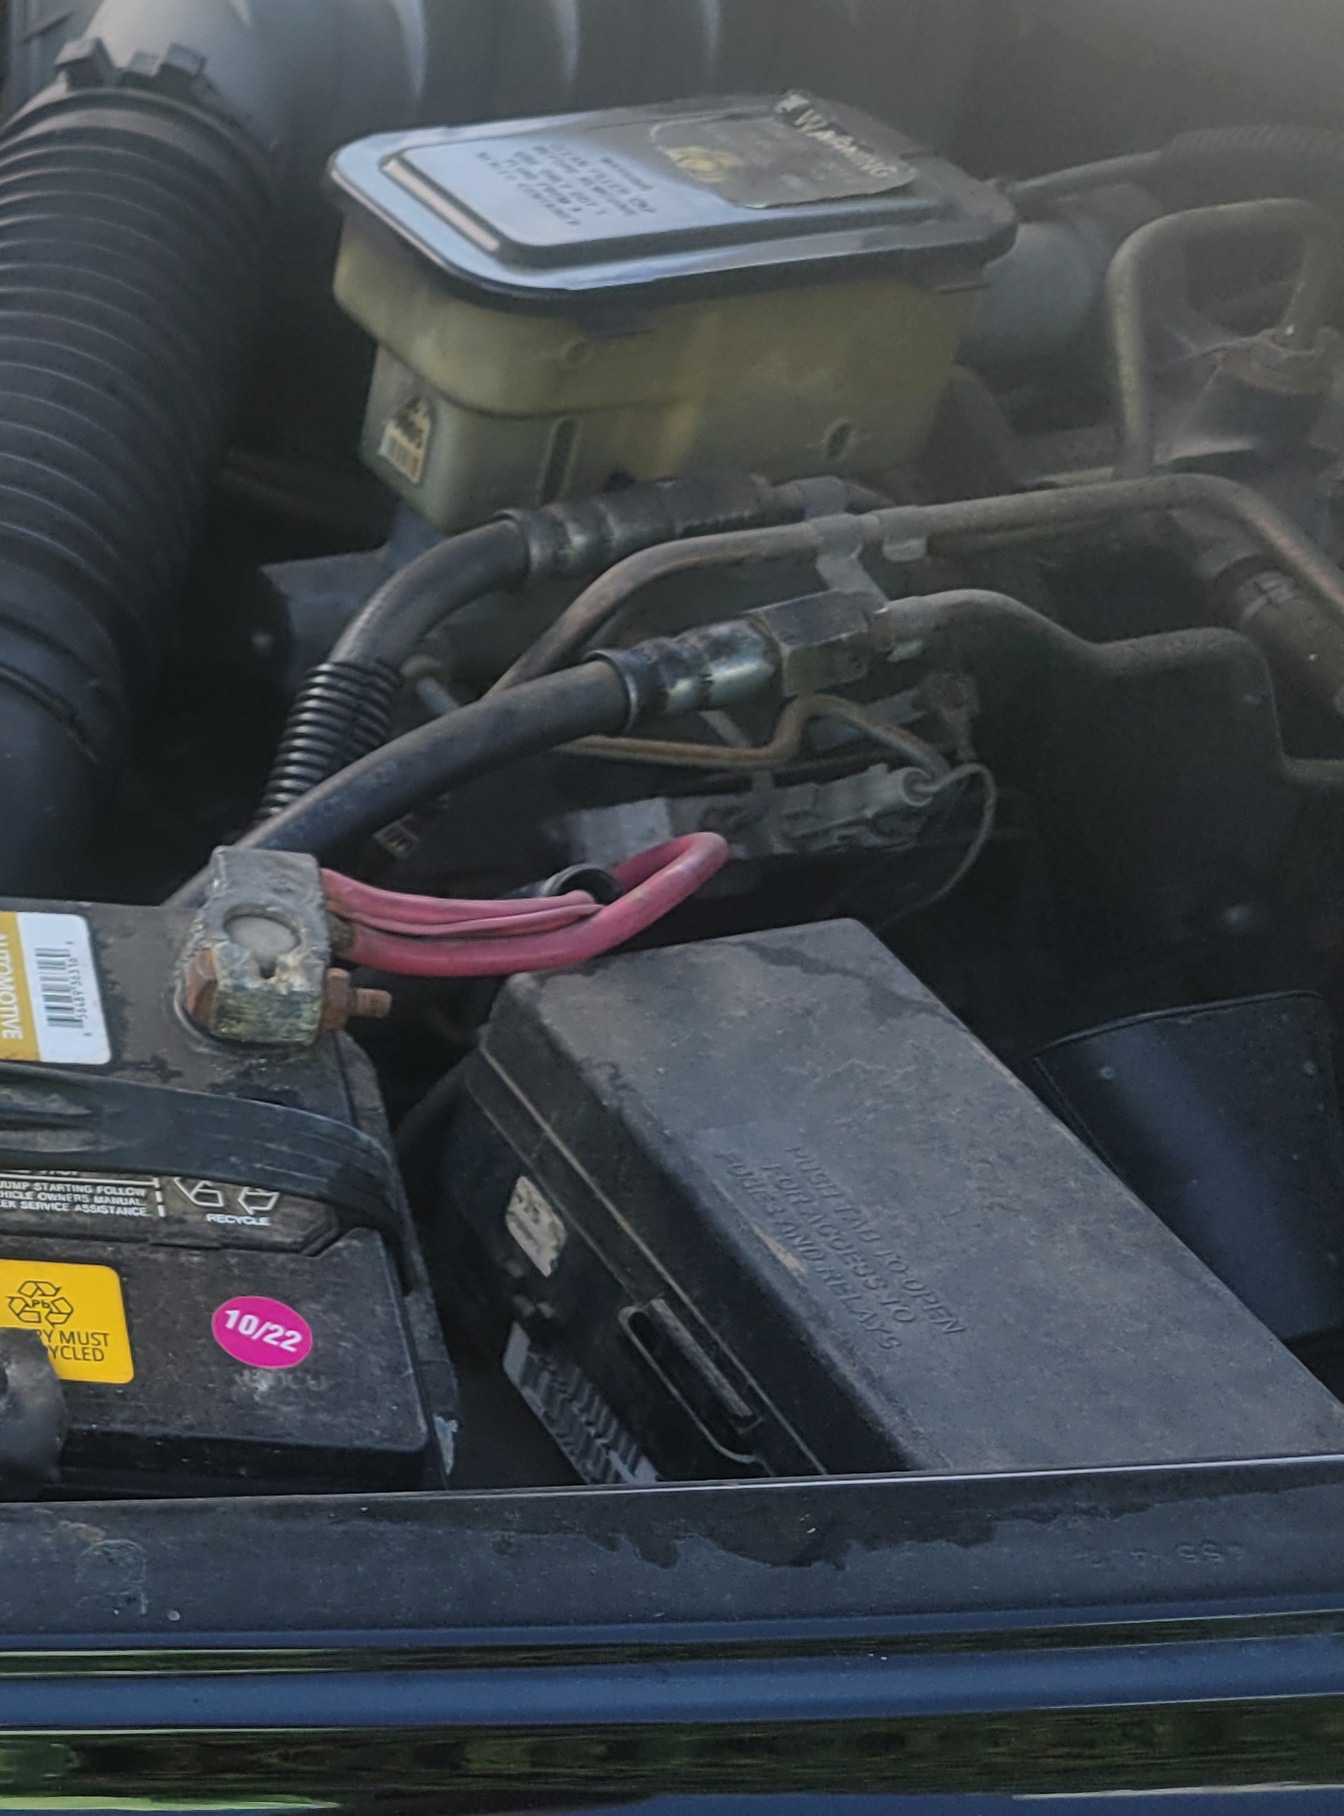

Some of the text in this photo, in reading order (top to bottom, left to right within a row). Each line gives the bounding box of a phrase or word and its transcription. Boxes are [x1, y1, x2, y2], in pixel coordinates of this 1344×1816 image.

[33, 1182, 93, 1195] STARTING
[97, 1186, 147, 1197] FOLLOW
[37, 1192, 90, 1203] OWNERS
[20, 1201, 69, 1212] SERVICE
[206, 1213, 271, 1226] RECYCLE
[32, 1299, 50, 1309] Pb
[224, 1309, 302, 1353] 10/22
[59, 1331, 109, 1347] MUST
